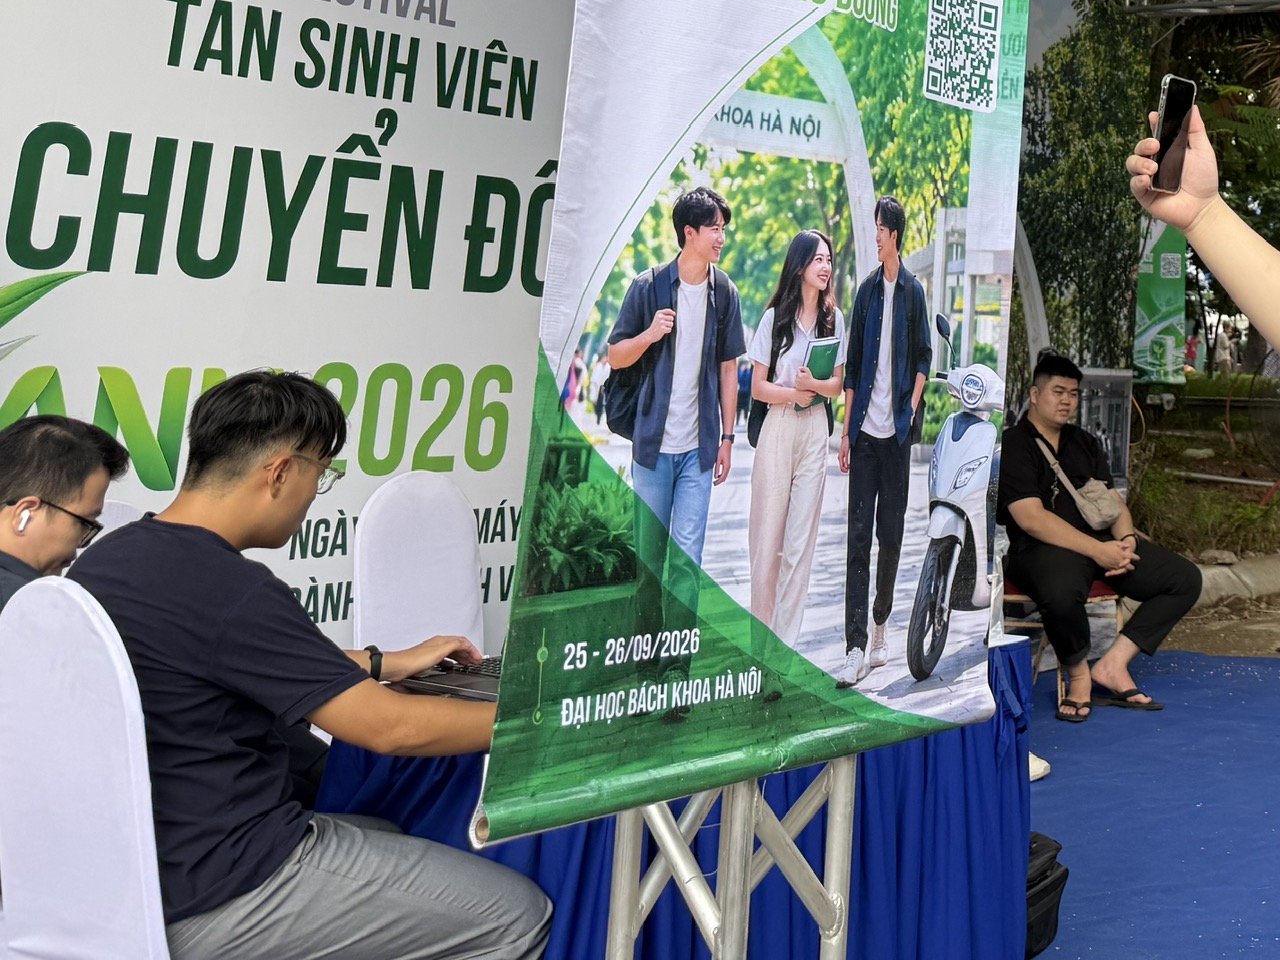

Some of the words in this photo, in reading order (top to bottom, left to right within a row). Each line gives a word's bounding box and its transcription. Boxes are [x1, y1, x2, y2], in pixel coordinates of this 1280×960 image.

[294, 17, 419, 104] SINH
[436, 39, 539, 121] VIÊN
[714, 104, 754, 129] HOA
[760, 108, 783, 134] HÀ
[789, 114, 821, 143] NỘI
[5, 108, 444, 291] CHUYỂN
[289, 509, 358, 560] NGÀ
[563, 641, 588, 671] 25
[604, 627, 700, 666] 26/09/2026
[560, 695, 591, 729] ĐẠI
[594, 691, 624, 724] HỌC
[627, 681, 668, 715] BÁCH
[671, 677, 711, 708] KHOA
[715, 669, 734, 700] HÀ
[738, 666, 762, 699] NỘI
